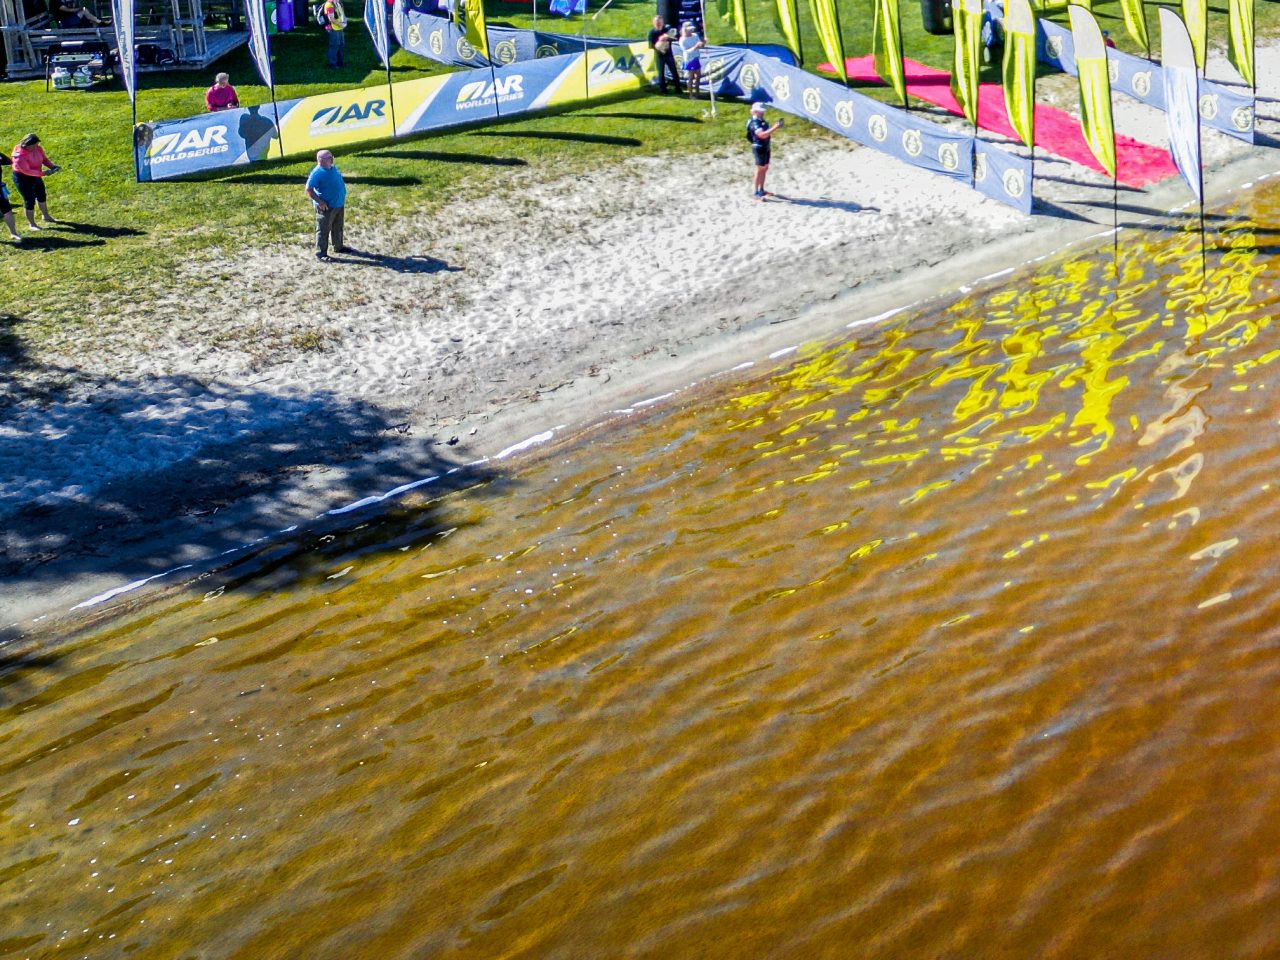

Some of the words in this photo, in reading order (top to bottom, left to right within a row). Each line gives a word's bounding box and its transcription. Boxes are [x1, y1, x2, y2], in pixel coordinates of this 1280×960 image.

[481, 74, 524, 98] AR
[337, 99, 386, 124] AR
[455, 99, 491, 111] WORLD
[174, 125, 228, 153] AR
[144, 151, 187, 166] WORLD
[187, 144, 229, 159] SERIES
